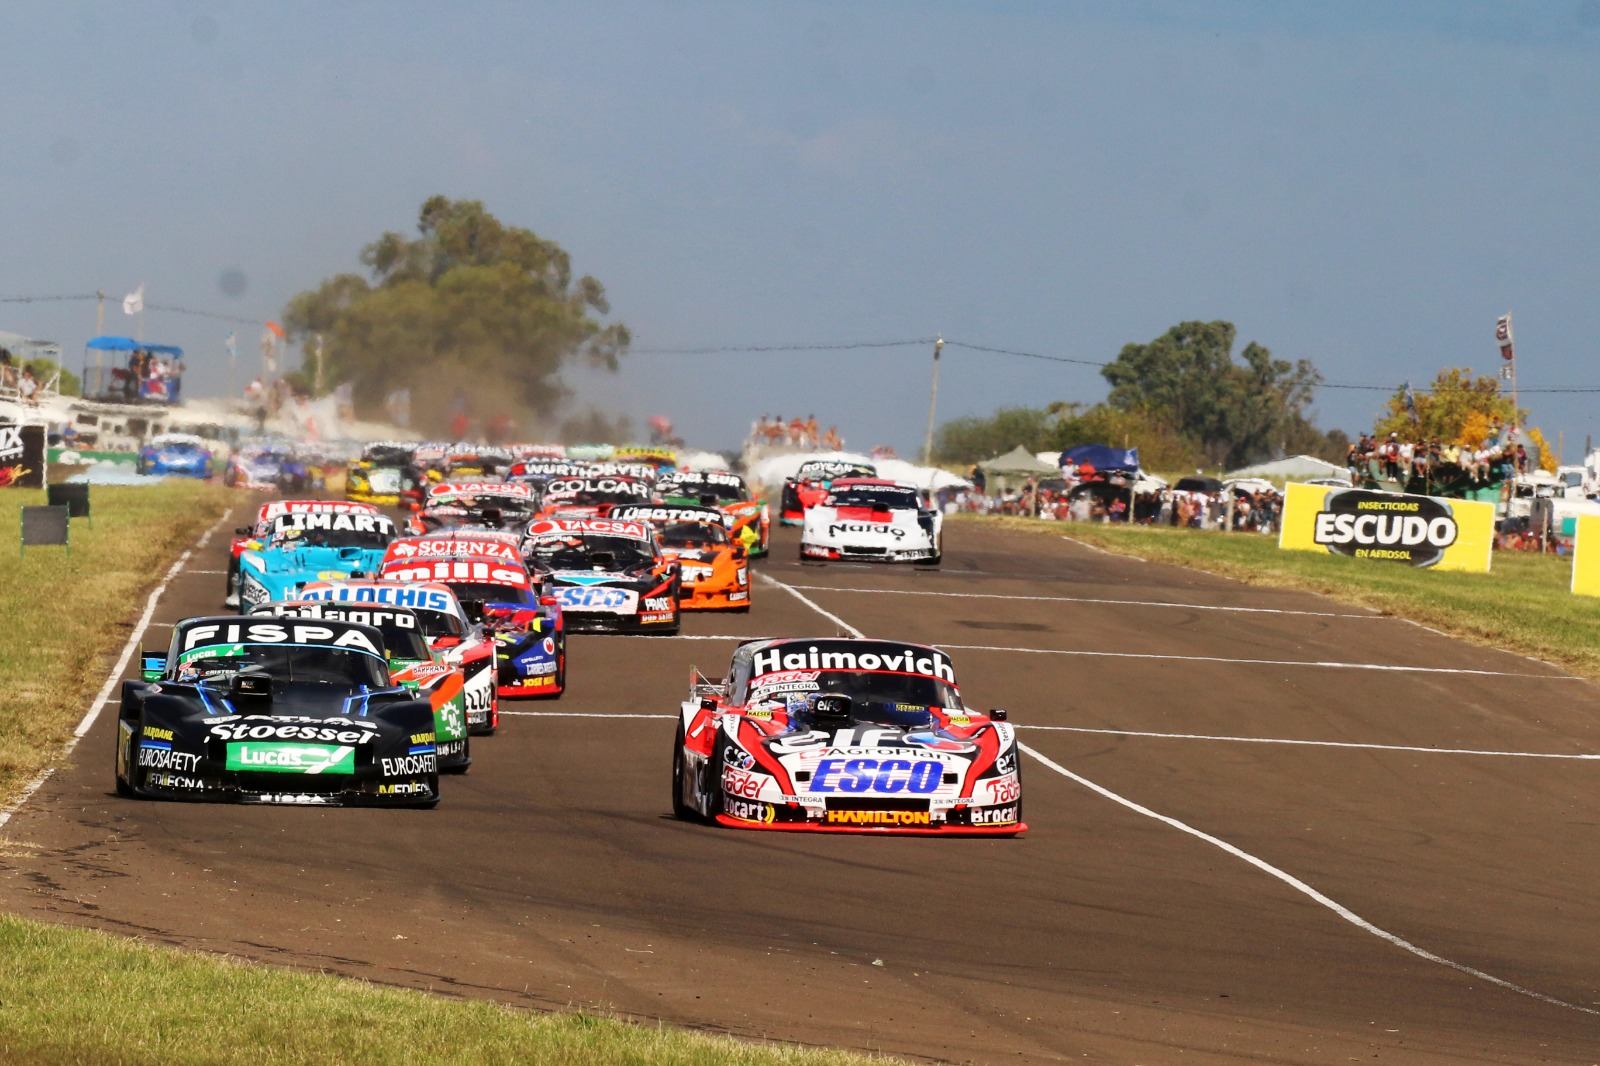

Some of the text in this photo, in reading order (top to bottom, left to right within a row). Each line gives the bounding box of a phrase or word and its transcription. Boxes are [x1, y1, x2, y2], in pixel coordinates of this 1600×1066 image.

[461, 484, 526, 494] TACSA
[548, 479, 648, 498] COLCAR
[707, 474, 741, 487] SUR
[1357, 501, 1420, 512] INSECTICIDAS
[275, 513, 394, 535] LIMART
[562, 520, 643, 535] TACSA
[1316, 513, 1456, 546] ESCUDO
[419, 541, 515, 560] SCIENZA
[1355, 549, 1411, 560] EN AEROSOL
[384, 563, 525, 584] milla
[184, 624, 381, 656] FISPA
[186, 650, 217, 661] Lucas
[754, 646, 954, 684] Haimovich
[775, 683, 818, 691] INTEGRA
[204, 723, 375, 744] Stoessel
[139, 748, 203, 773] EUROSAFETY
[240, 746, 303, 765] Lucas
[808, 759, 944, 793] ESCO
[828, 810, 930, 824] HAMILTON
